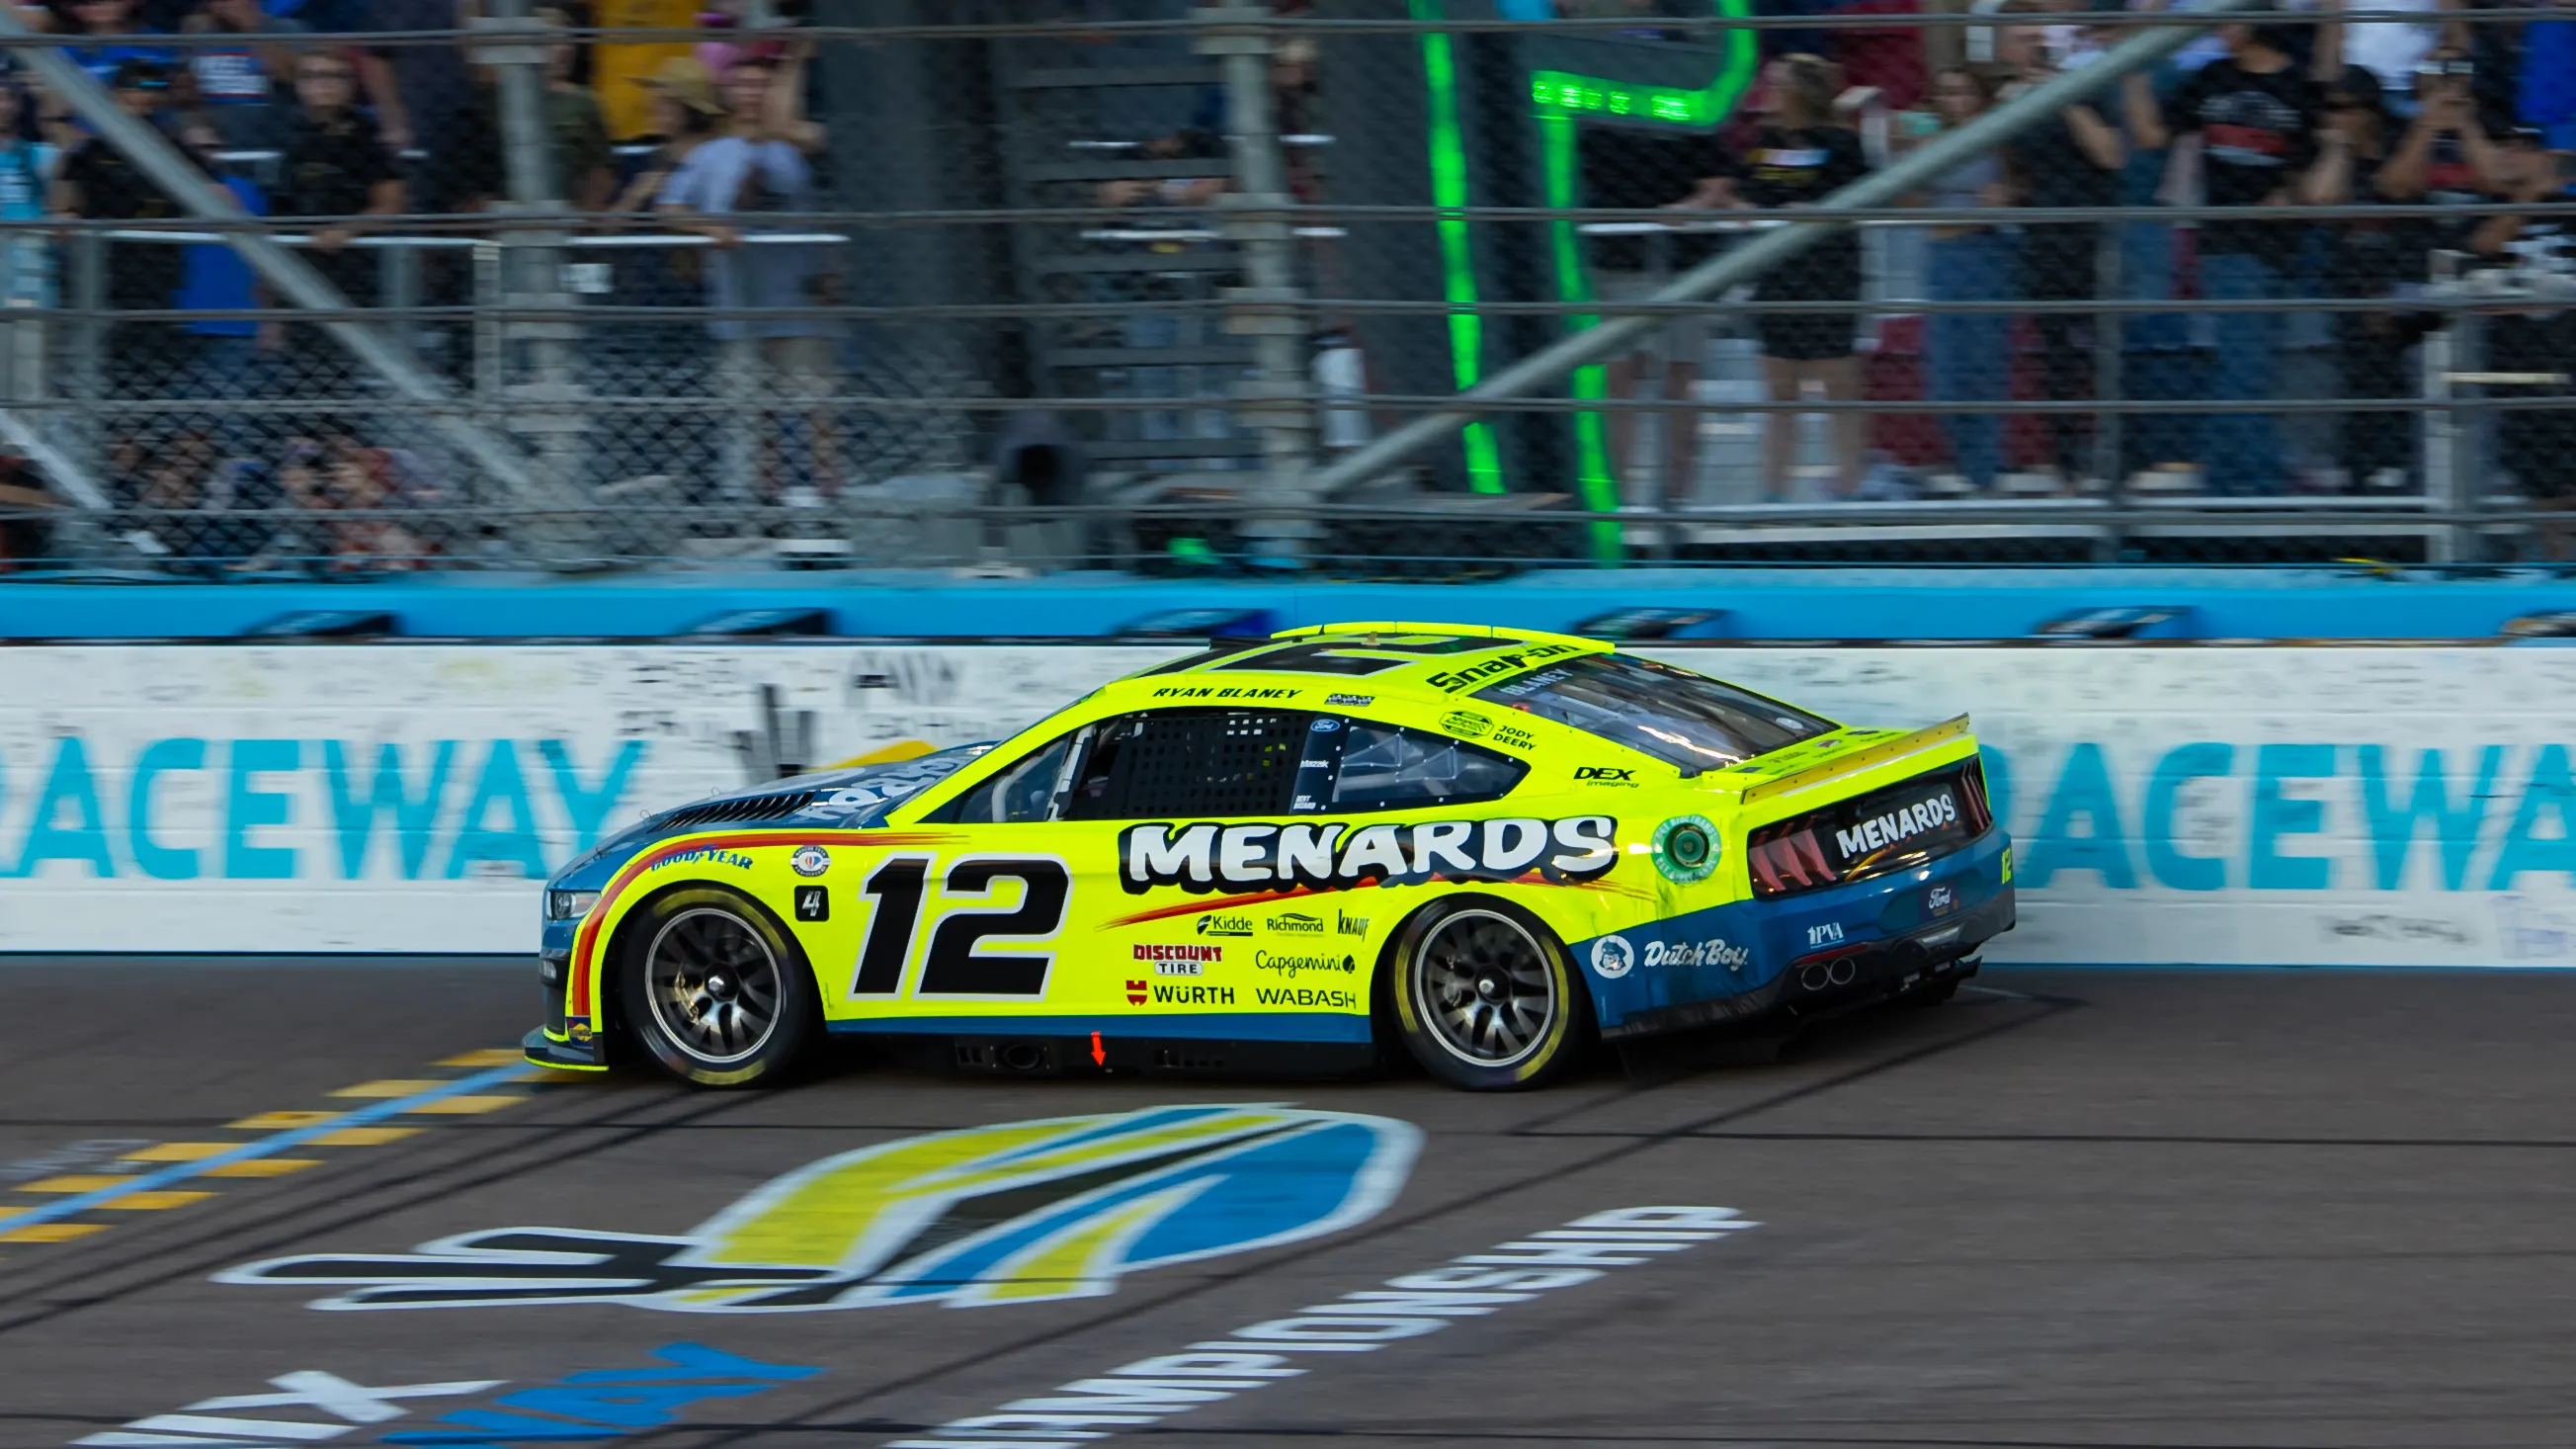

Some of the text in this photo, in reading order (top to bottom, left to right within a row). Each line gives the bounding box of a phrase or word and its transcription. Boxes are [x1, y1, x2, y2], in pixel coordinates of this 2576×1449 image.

[1152, 687, 1303, 699] RYAN BLANEY
[1312, 720, 1337, 731] Ford
[1498, 724, 1536, 740] JODY
[1492, 732, 1537, 751] DEERY
[1573, 766, 1636, 781] DEX
[1586, 779, 1639, 789] imaging
[0, 736, 648, 880] ACEWAY
[1836, 794, 1956, 859] MENARDS
[650, 844, 754, 872] GOODYEAR
[1122, 815, 1617, 890] MENARDS
[1929, 887, 1952, 909] Ford
[848, 853, 1075, 1000] 12
[1212, 915, 1253, 931] Kidde
[1267, 915, 1324, 932] Richmond
[1337, 908, 1370, 942] KNAUF
[1133, 944, 1222, 962] DISCOUNT
[1644, 940, 1705, 967] Dutch
[1158, 963, 1199, 975] TIRE
[1255, 949, 1342, 979] Capgemini
[1256, 988, 1357, 1009] WABASH
